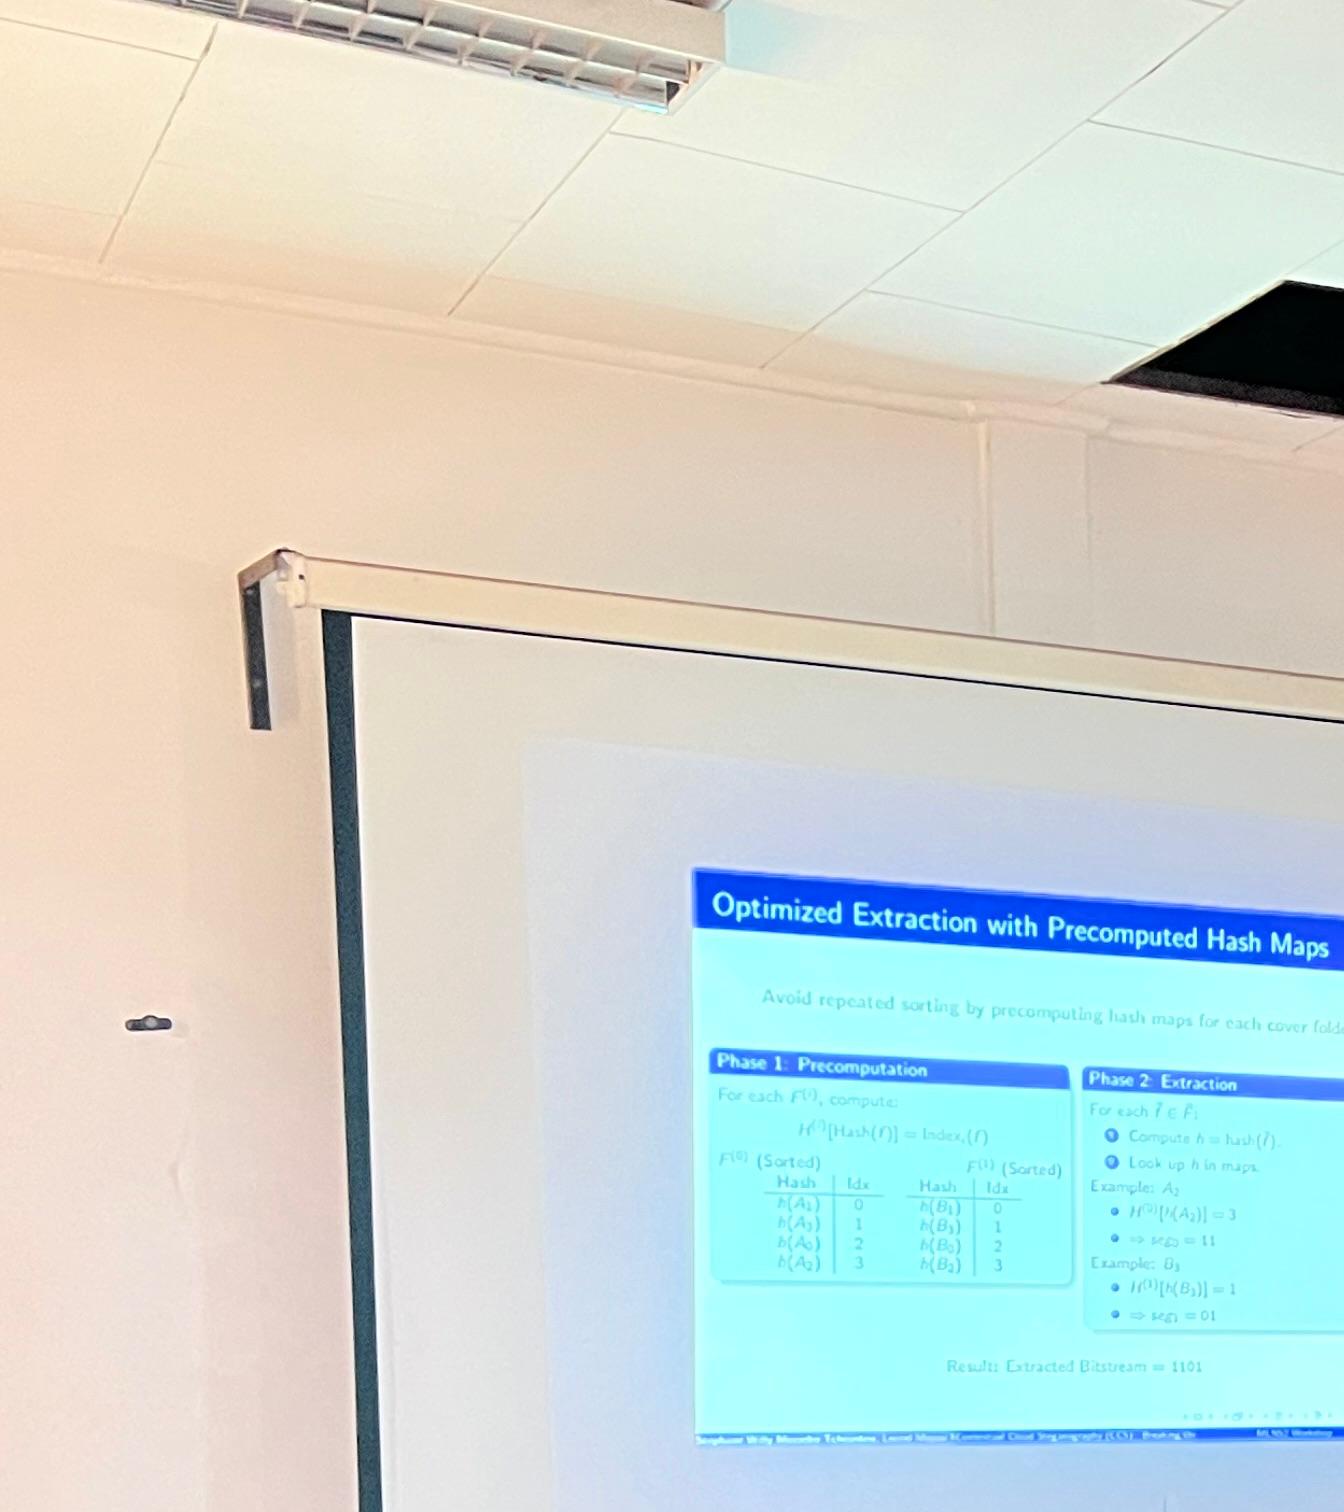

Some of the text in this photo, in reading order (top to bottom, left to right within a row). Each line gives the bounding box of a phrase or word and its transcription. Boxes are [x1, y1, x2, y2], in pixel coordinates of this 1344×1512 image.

[712, 890, 1330, 962] Optimized Extraction with Precomputed Hash Maps
[762, 988, 812, 1006] Avoid
[819, 992, 895, 1012] repeated
[901, 995, 960, 1017] sorting
[966, 999, 984, 1019] by
[991, 1004, 1103, 1025] precomputing
[1108, 1007, 1146, 1024] hash
[1152, 1014, 1193, 1030] maps
[1200, 1012, 1219, 1028] for
[1226, 1016, 1262, 1031] each
[1267, 1020, 1308, 1033] cover
[717, 1052, 767, 1071] Phase
[797, 1056, 928, 1079] Precomputation
[1088, 1071, 1135, 1088] Phase
[1161, 1074, 1238, 1092] Extraction
[718, 1087, 743, 1103] For
[748, 1088, 784, 1104] each
[1090, 1103, 1112, 1118] For
[1117, 1105, 1148, 1118] each
[1129, 1129, 1190, 1147] Compute
[756, 1153, 822, 1172] (Sorted)
[1001, 1160, 1063, 1179] (Sorted)
[1129, 1156, 1162, 1171] Look
[1168, 1160, 1185, 1173] up
[1204, 1158, 1216, 1172] in
[776, 1175, 871, 1190] Hash Idx
[919, 1179, 1009, 1195] Hash Idx
[1091, 1179, 1155, 1196] Example:
[854, 1198, 864, 1211] 0
[993, 1201, 1003, 1215] 0
[1228, 1208, 1237, 1221] 3
[854, 1237, 864, 1251] 2
[993, 1240, 1003, 1253] 2
[1201, 1234, 1216, 1247] 11
[855, 1256, 865, 1270] 3
[993, 1259, 1003, 1273] 3
[1091, 1256, 1155, 1272] Example:
[1200, 1309, 1216, 1322] 01
[1007, 1359, 1074, 1374] Extracted
[1080, 1359, 1147, 1374] Bitstream
[1172, 1360, 1202, 1374] 1101
